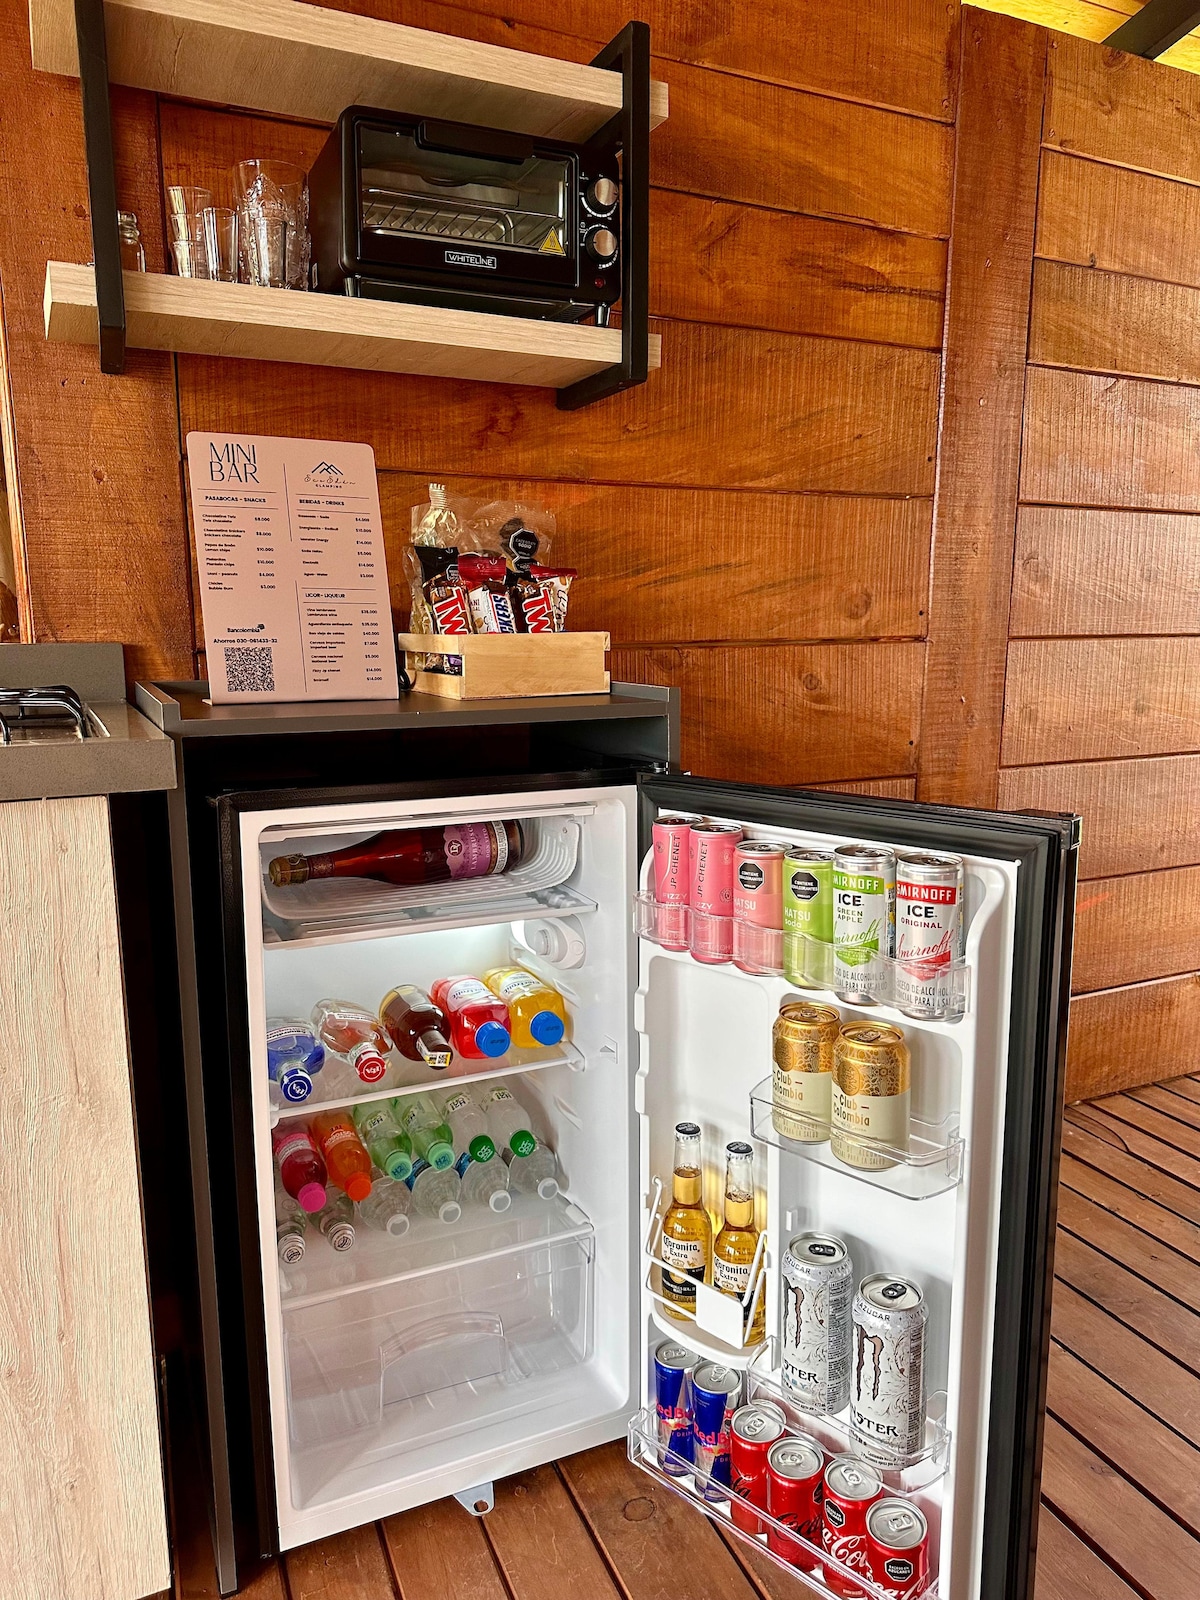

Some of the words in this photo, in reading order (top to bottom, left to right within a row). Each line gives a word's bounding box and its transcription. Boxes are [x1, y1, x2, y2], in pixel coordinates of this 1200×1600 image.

[448, 253, 494, 266] WHITELINE
[209, 442, 257, 464] MINI
[209, 461, 260, 484] BAR
[672, 835, 681, 875] CHENET
[698, 841, 708, 882] CHENET
[670, 877, 677, 889] JP
[697, 885, 703, 897] JP
[896, 883, 953, 902] SMIRNOFF
[838, 893, 862, 906] ICE
[784, 906, 811, 921] HATSU
[837, 907, 864, 917] GREEN
[907, 905, 936, 918] ICE
[784, 918, 802, 928] soda
[837, 914, 863, 924] APPLE
[900, 917, 943, 929] ORIGINAL
[911, 983, 920, 994] DE
[914, 994, 931, 1007] PARA
[776, 1070, 792, 1086] Club
[839, 1093, 858, 1111] Club
[833, 1102, 870, 1127] Colombia
[669, 1247, 688, 1259] Extra
[785, 1255, 811, 1275] AZUCAR
[719, 1269, 738, 1282] Extra
[858, 1302, 891, 1322] AZUCAR
[693, 1421, 715, 1444] Red
